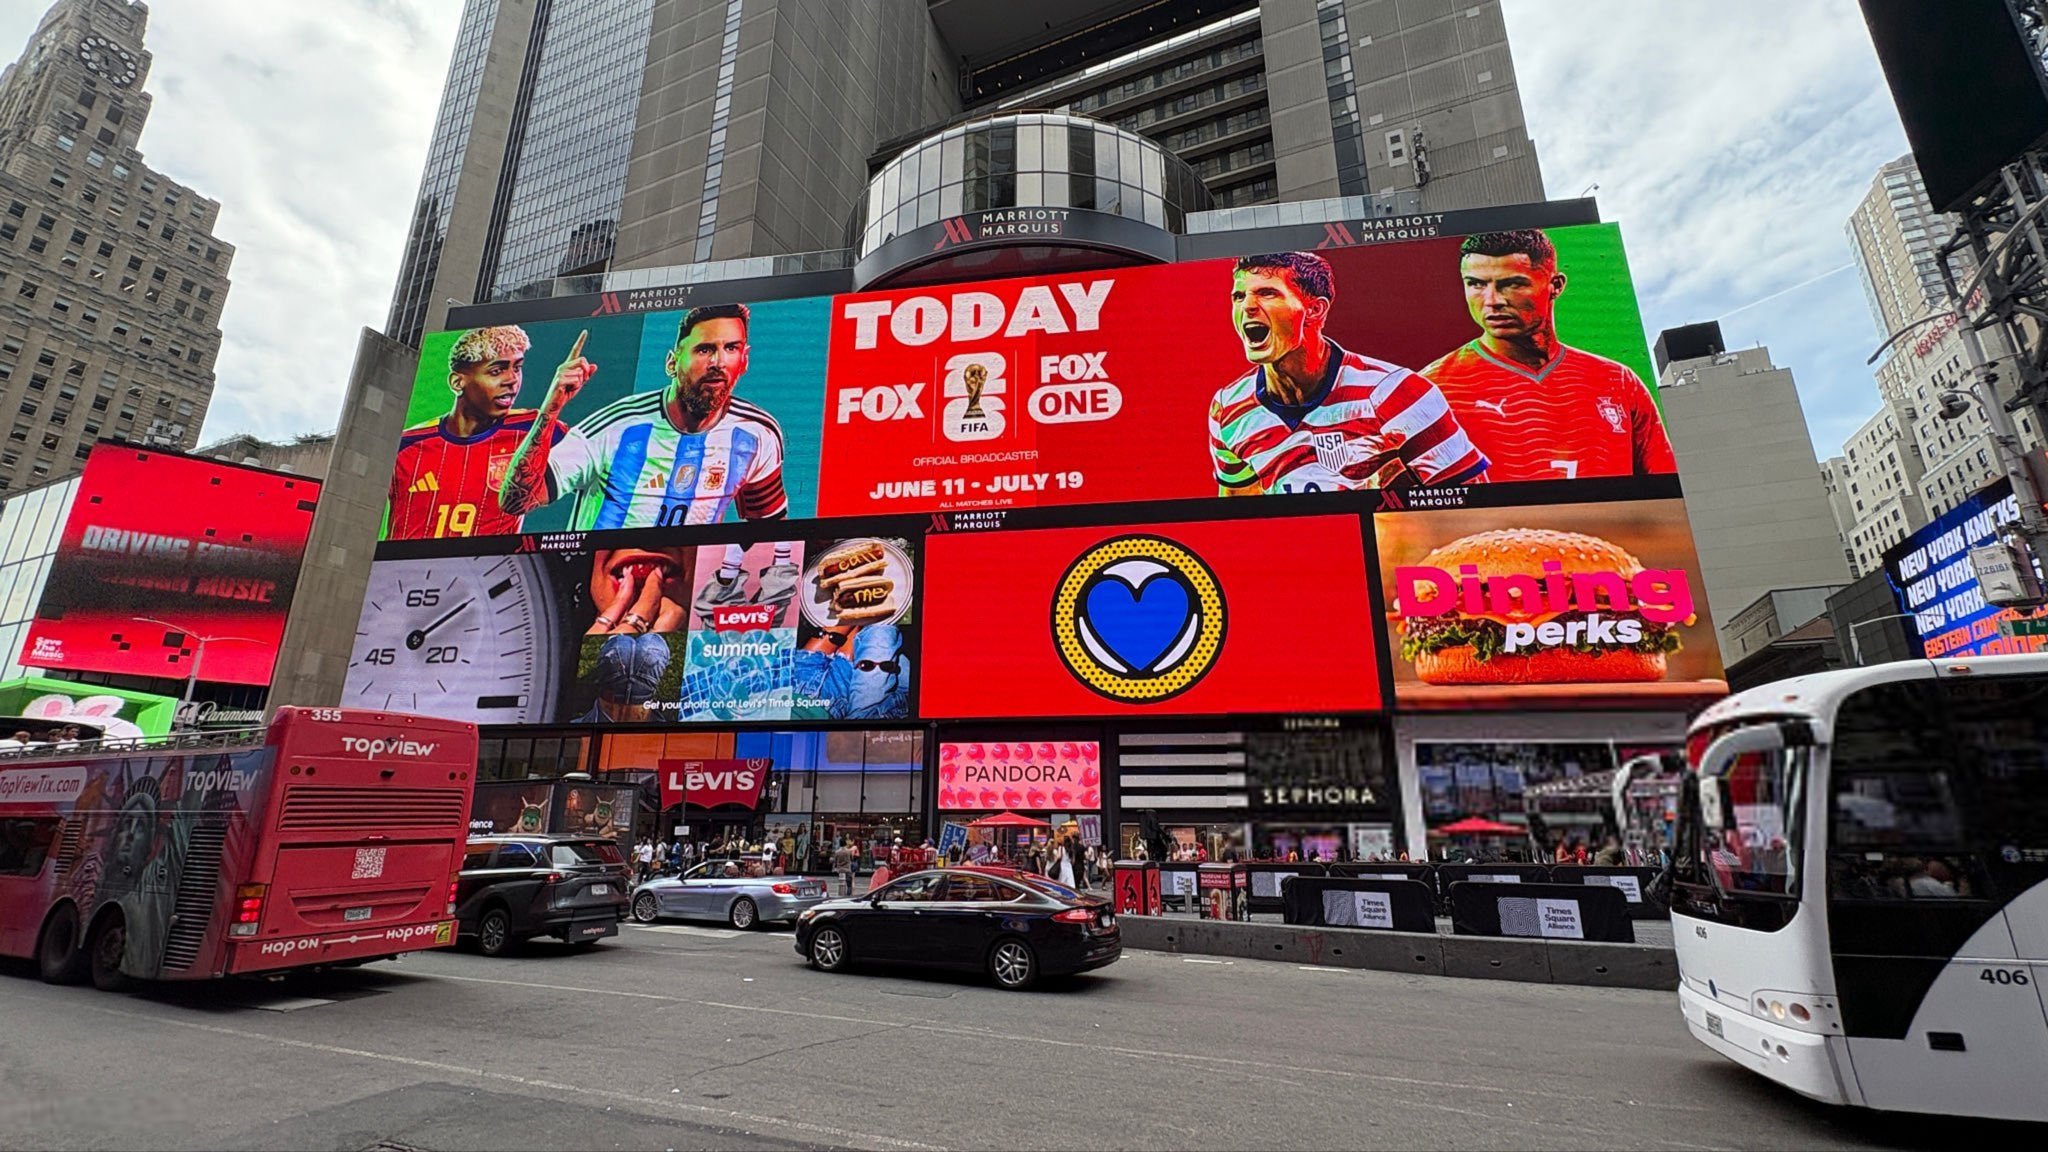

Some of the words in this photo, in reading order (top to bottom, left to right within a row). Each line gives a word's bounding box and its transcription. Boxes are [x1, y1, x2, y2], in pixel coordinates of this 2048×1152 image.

[982, 210, 1069, 223] MARRIOTT
[1362, 214, 1443, 231] MARRIOTT
[982, 223, 1059, 237] MARQUIS
[1364, 227, 1436, 242] MARQUIS
[630, 286, 693, 300] MARRIOTT
[628, 297, 684, 310] MARQUIS
[844, 279, 1116, 350] TODAY
[1041, 351, 1110, 385] FOX
[836, 382, 927, 425] FOX
[1039, 388, 1110, 417] ONE
[961, 422, 989, 433] FIFA
[1316, 434, 1343, 451] USA
[913, 456, 958, 467] OFFICIAL
[960, 450, 1039, 466] BROADCASTER
[869, 481, 936, 500] JUNE
[942, 479, 966, 496] 11
[986, 474, 1050, 493] JULY
[1057, 470, 1084, 489] 19
[1408, 487, 1469, 497] MARRIOTT
[956, 499, 994, 507] MATCHES
[1410, 497, 1464, 507] MARQUIS
[434, 504, 477, 539] 19
[955, 511, 1007, 520] MARRIOTT
[955, 521, 1000, 530] MARQUIS
[82, 524, 190, 559] DRIVING
[542, 532, 587, 542] MARRIOTT
[540, 541, 580, 550] MARQUIS
[1899, 547, 1928, 582] NEW
[1928, 527, 1966, 566] YORK
[1907, 575, 1938, 609] NEW
[1936, 556, 1976, 593] YORK
[406, 588, 441, 608] 65
[1395, 560, 1694, 623] Dining
[1915, 603, 1946, 636] NEW
[1944, 586, 1985, 622] YORK
[1504, 614, 1642, 653] perks
[703, 642, 779, 657] summer
[1924, 625, 1972, 659] EASTERN
[364, 648, 396, 666] 45
[425, 646, 458, 664] 20
[643, 701, 662, 710] Get
[664, 702, 682, 713] your
[684, 700, 710, 710] shorts
[712, 701, 724, 709] on
[769, 697, 794, 708] Times
[797, 698, 831, 711] Square
[310, 710, 343, 723] 355
[966, 766, 1071, 782] PANDORA
[1263, 788, 1378, 804] SEPHORA
[1361, 905, 1387, 914] Square
[1362, 898, 1385, 907] Times
[1545, 906, 1572, 915] Times
[1545, 914, 1576, 923] Square
[1548, 922, 1576, 930] Alliance
[415, 925, 439, 937] OFF
[297, 938, 320, 950] ON
[1980, 968, 2029, 985] 406
